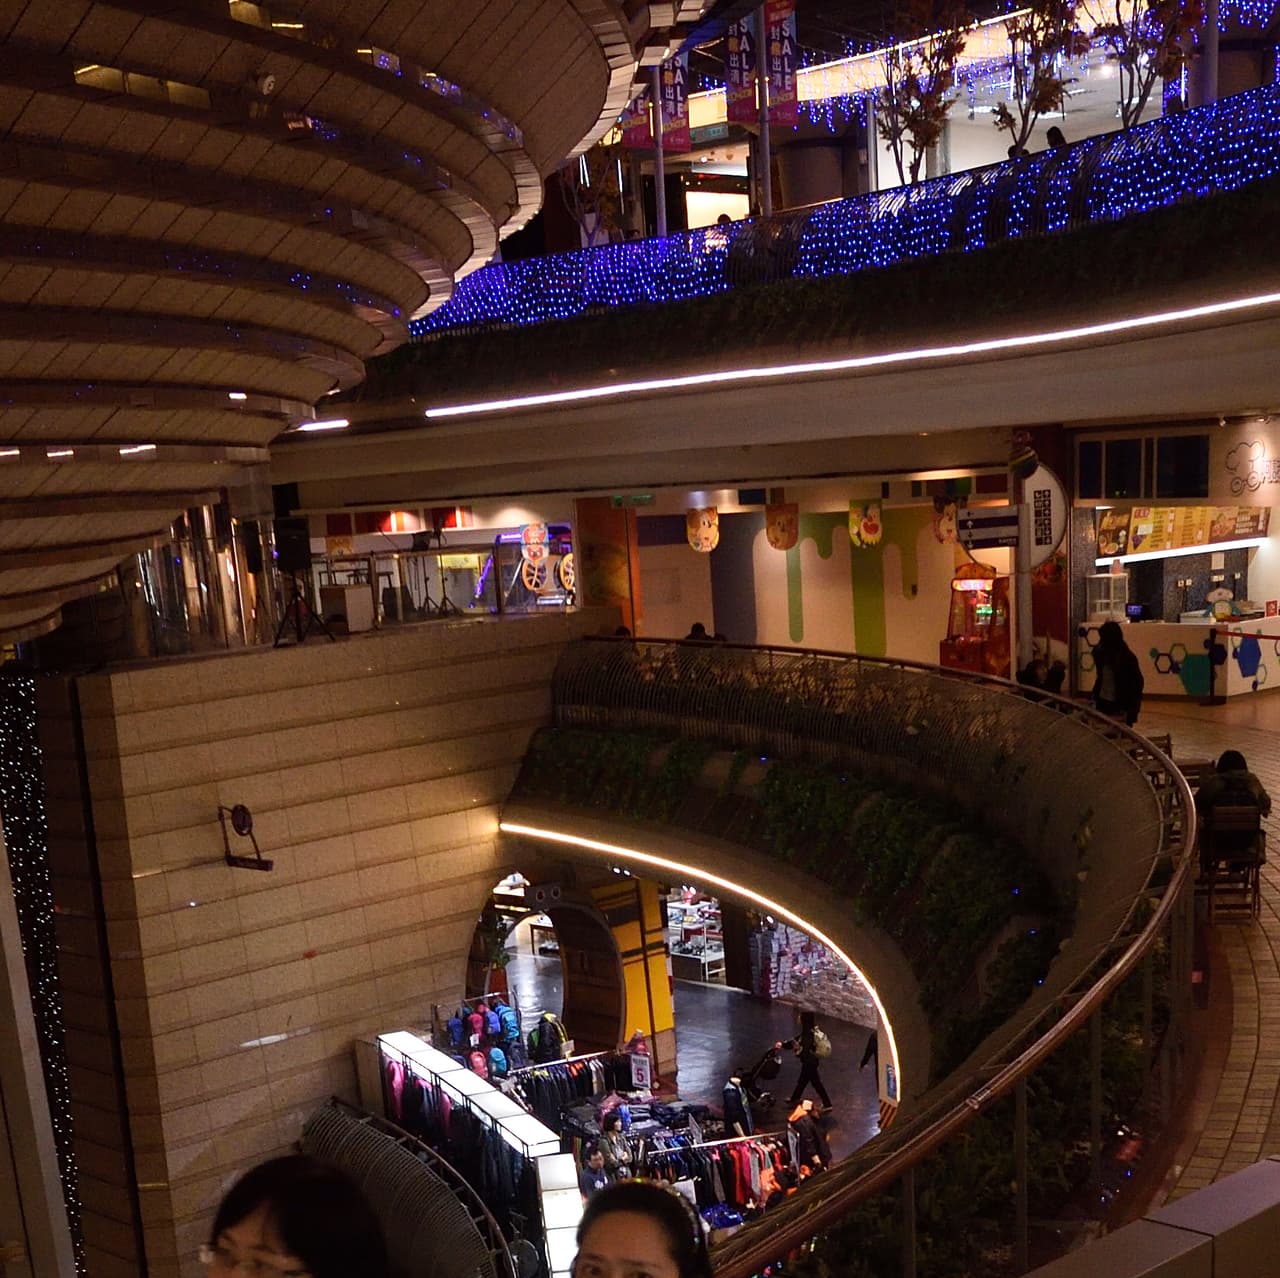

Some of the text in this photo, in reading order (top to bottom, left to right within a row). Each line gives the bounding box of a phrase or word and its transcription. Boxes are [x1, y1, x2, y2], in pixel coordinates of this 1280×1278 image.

[674, 56, 685, 118] SALE
[740, 17, 751, 88] SALE
[782, 20, 792, 91] SALE
